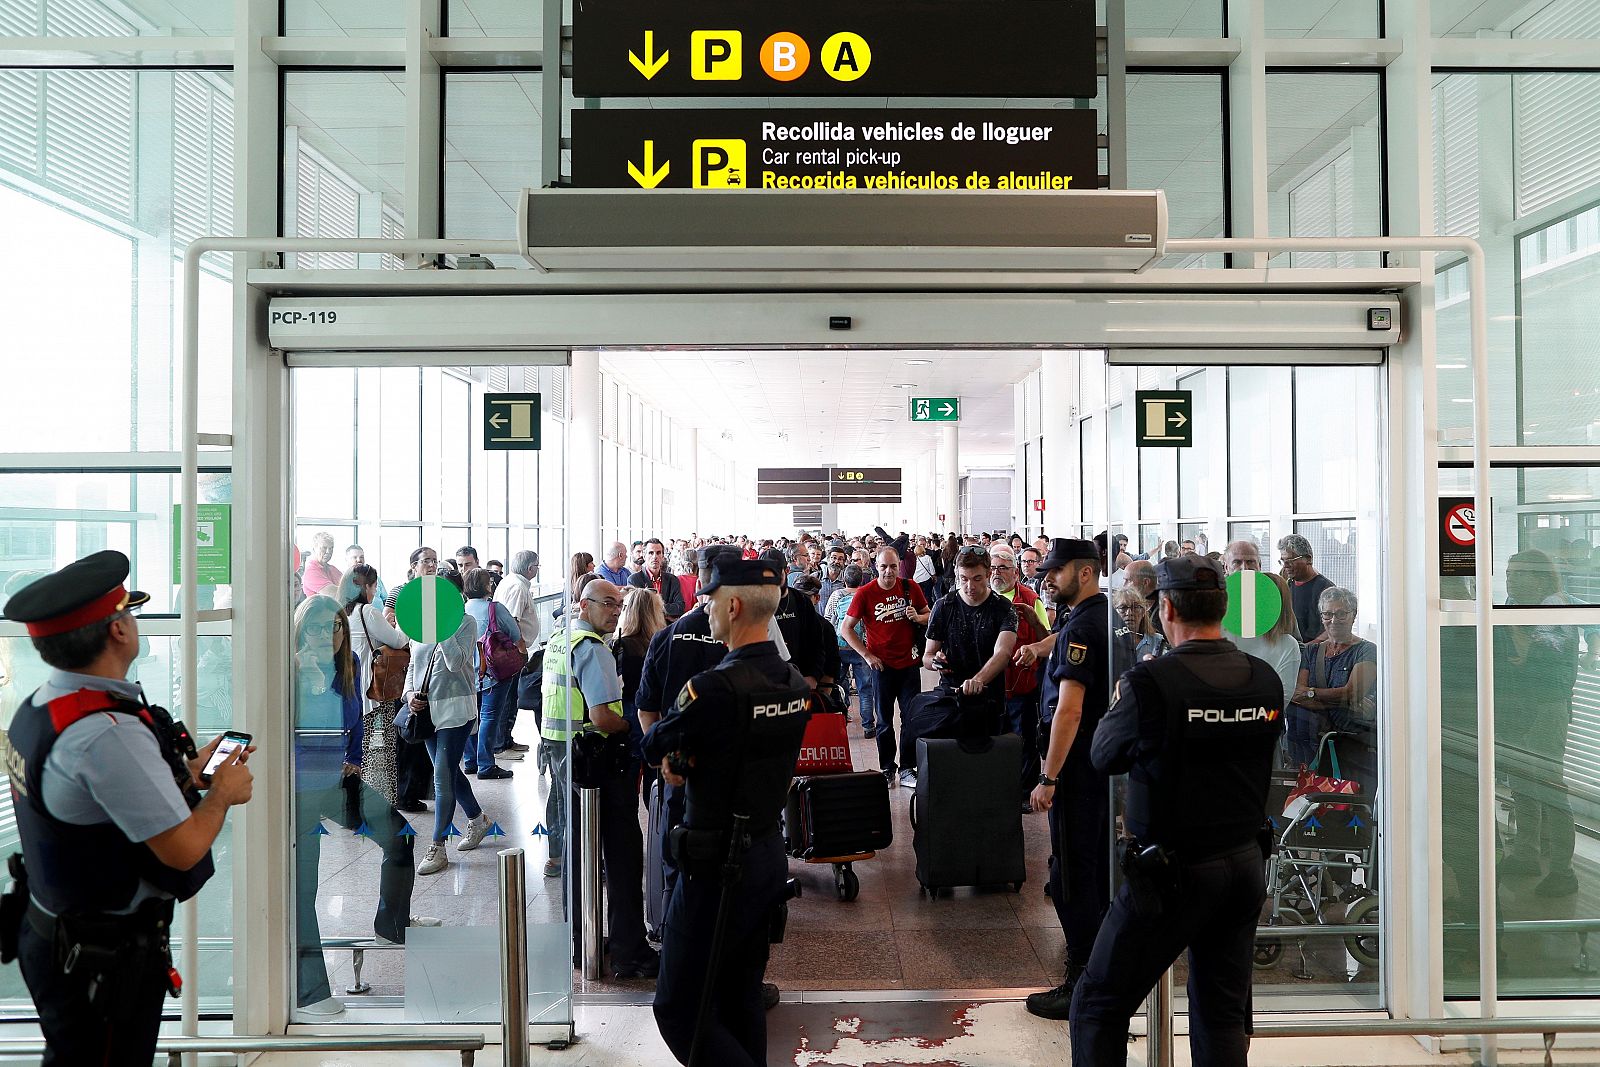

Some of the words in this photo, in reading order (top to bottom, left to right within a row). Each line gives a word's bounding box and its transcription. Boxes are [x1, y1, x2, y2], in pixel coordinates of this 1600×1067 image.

[704, 38, 732, 73] P
[773, 41, 797, 72] B
[832, 41, 859, 72] A
[762, 121, 855, 141] Recollida
[861, 121, 944, 141] vehicles
[950, 121, 976, 141] de
[982, 121, 1053, 145] lloguer
[700, 146, 729, 186] P
[762, 147, 790, 165] Car
[796, 147, 840, 165] rental
[846, 147, 901, 168] pick-up
[762, 170, 857, 189] Recogida
[864, 170, 959, 189] vehículos
[965, 170, 991, 189] de
[997, 170, 1073, 189] alquiler
[272, 311, 337, 324] PCP-119
[753, 698, 806, 719] POLICIA
[1188, 706, 1268, 722] POLICIA
[797, 747, 828, 761] CALA
